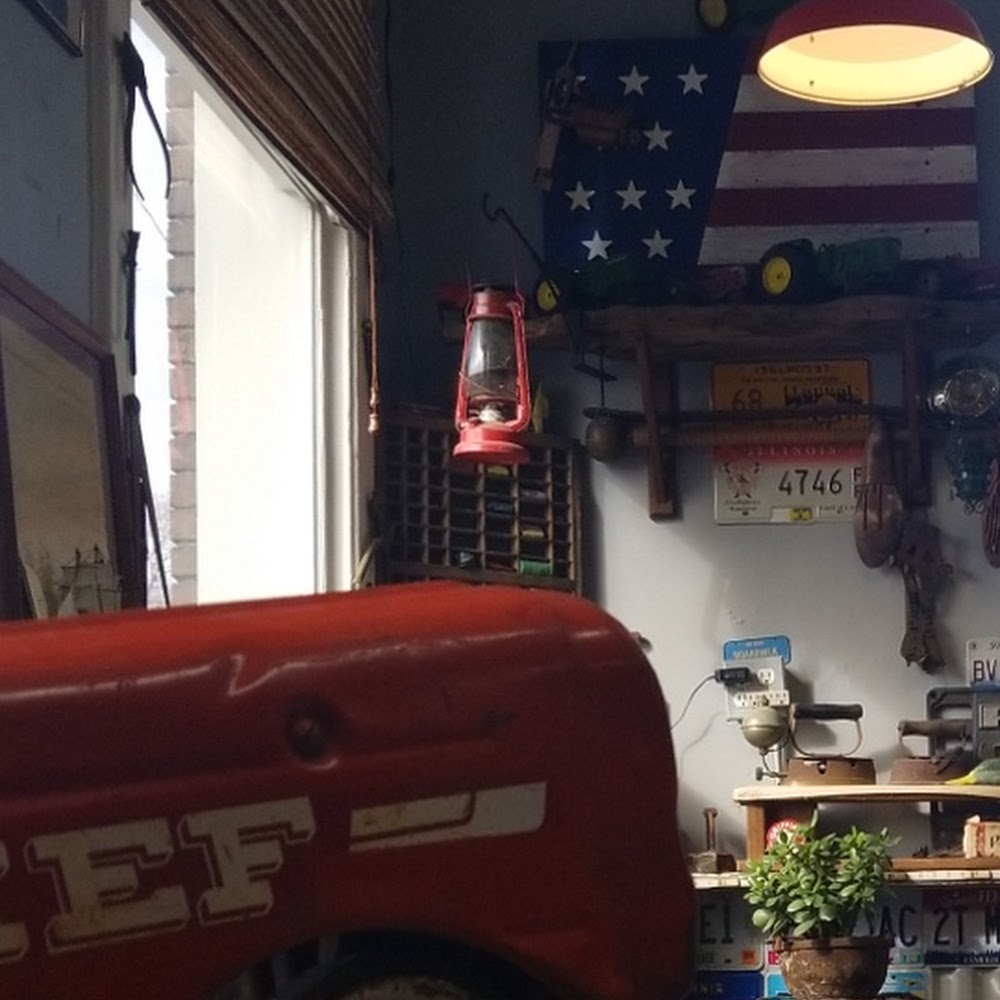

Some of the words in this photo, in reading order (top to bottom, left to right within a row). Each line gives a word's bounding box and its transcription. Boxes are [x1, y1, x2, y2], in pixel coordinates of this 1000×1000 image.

[778, 469, 843, 496] 4746
[973, 660, 997, 682] BV
[933, 906, 968, 945] 2T
